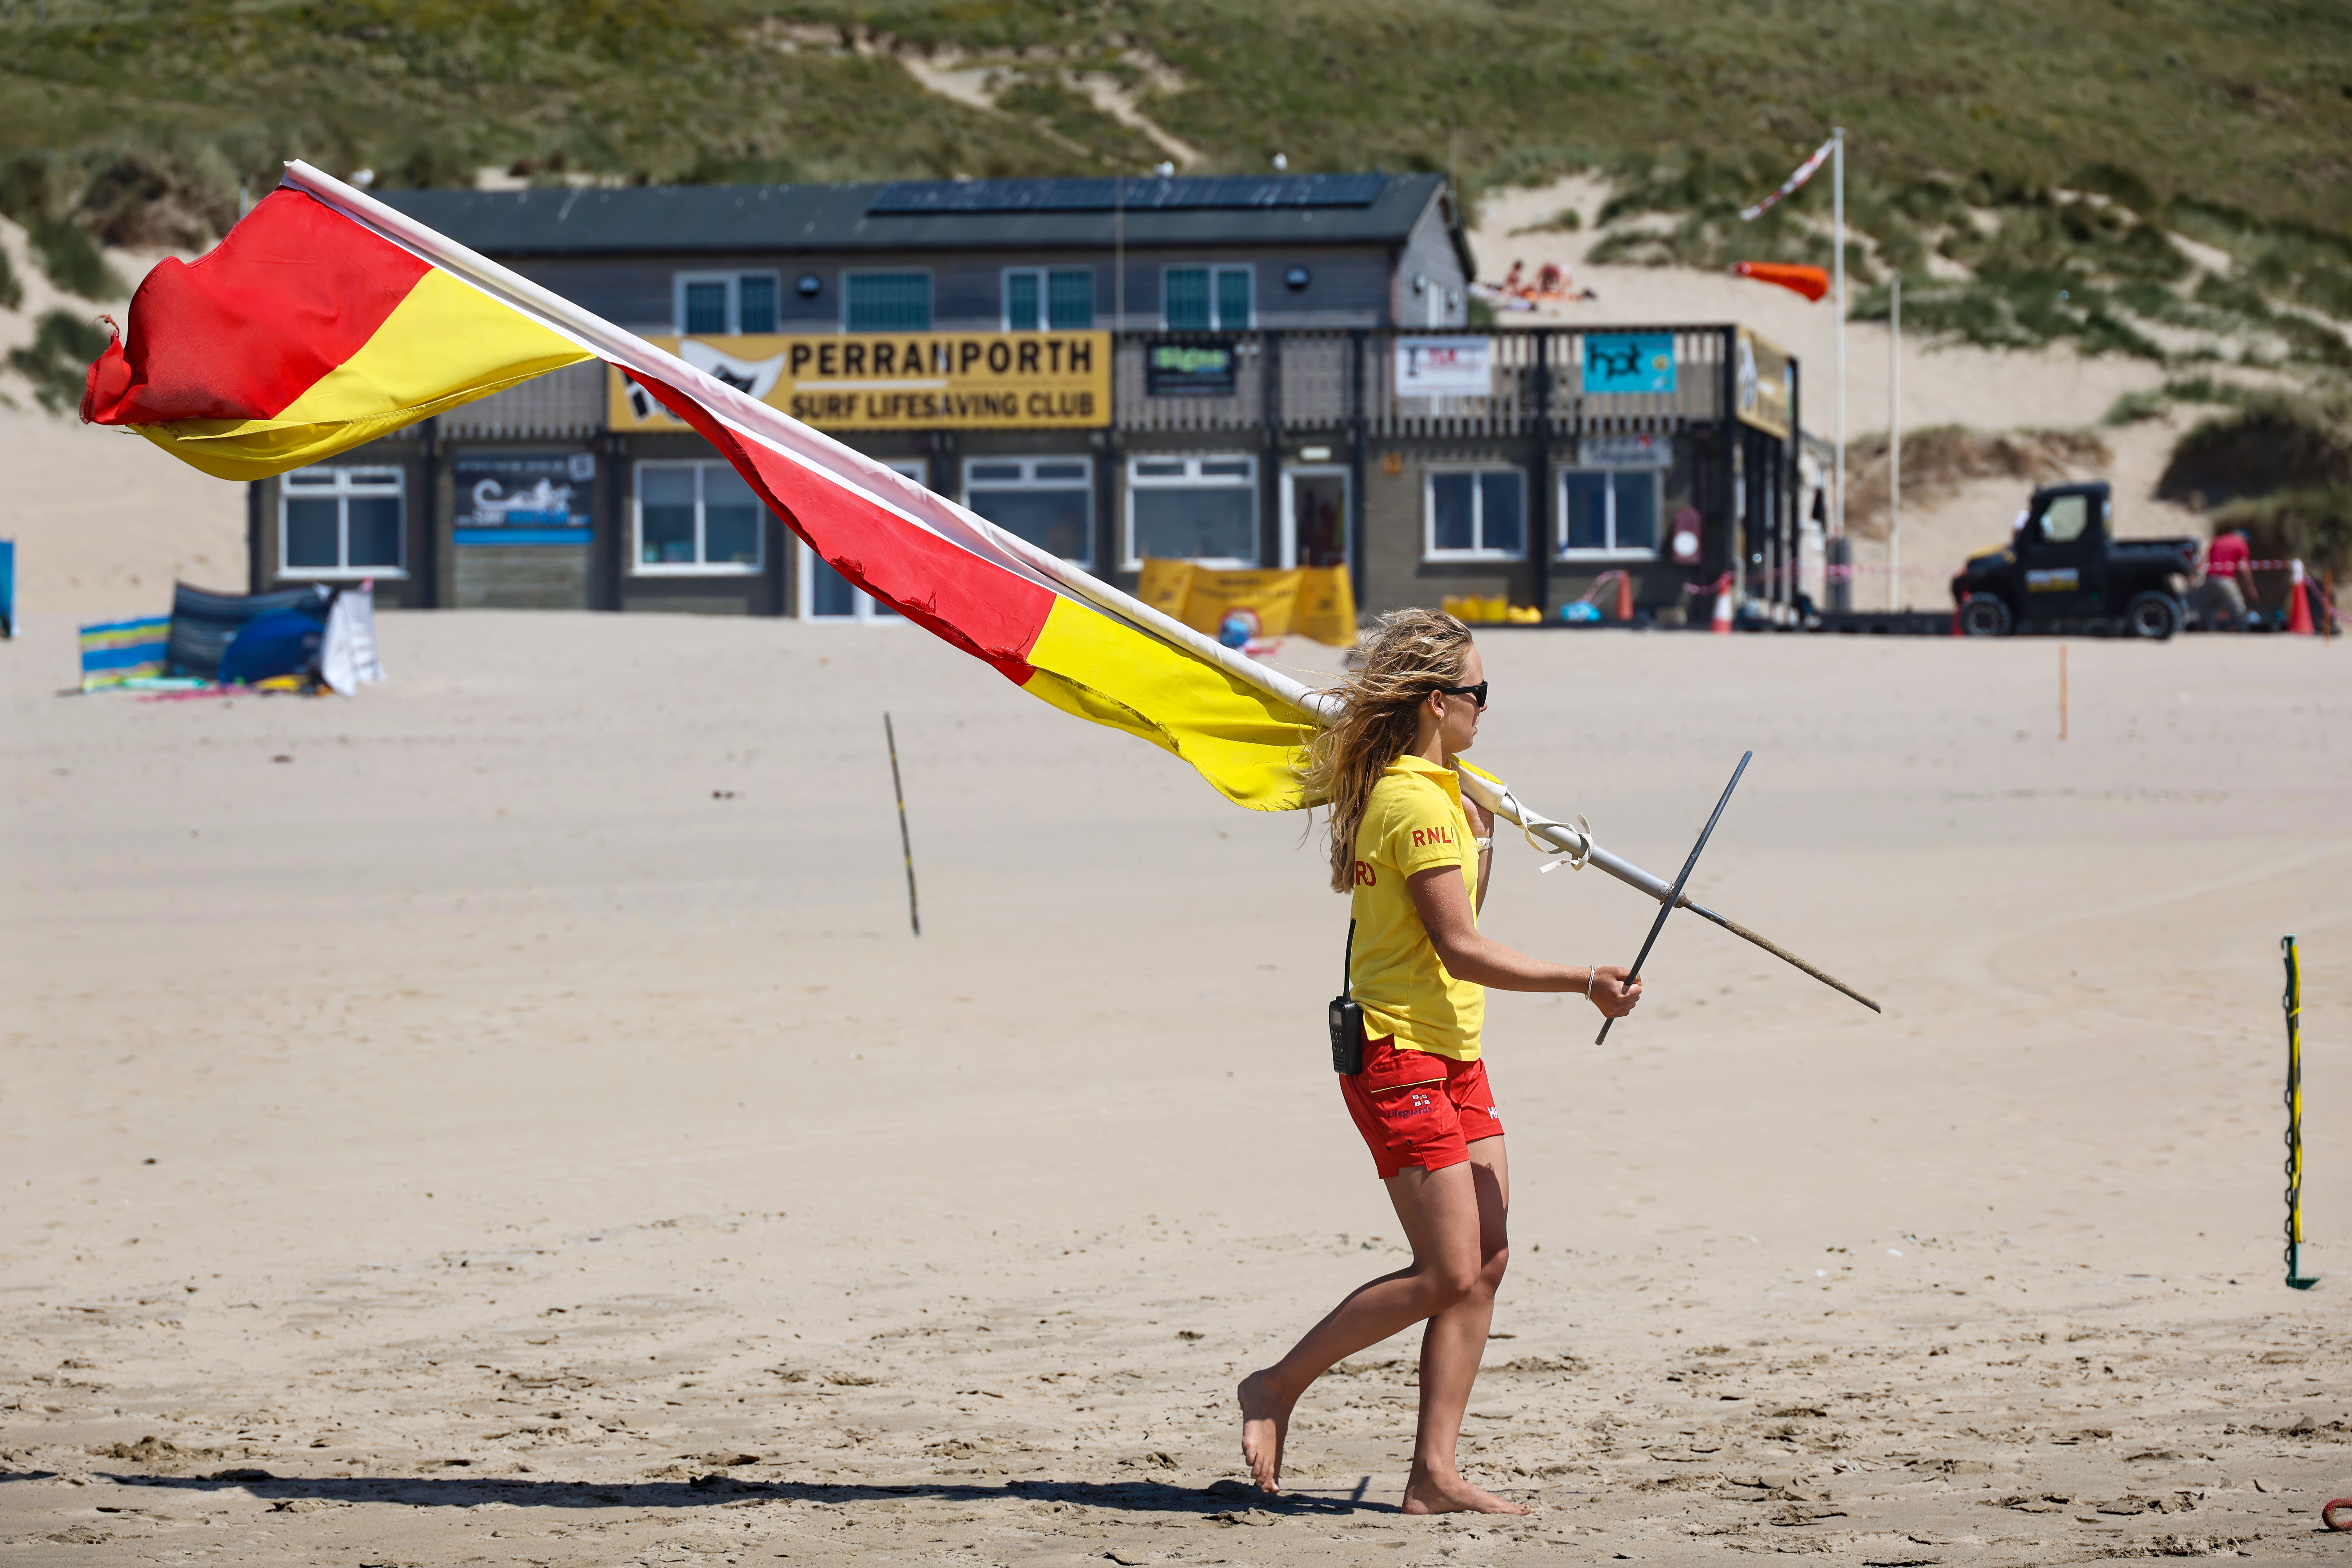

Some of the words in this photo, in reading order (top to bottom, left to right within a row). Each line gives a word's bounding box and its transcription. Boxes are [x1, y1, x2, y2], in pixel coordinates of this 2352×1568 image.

[791, 340, 1091, 375] PERRANPORTH
[792, 394, 858, 419] SURF
[867, 392, 1018, 418] LIFESAVING
[1027, 392, 1094, 417] CLUB
[1388, 1105, 1433, 1118] Lifeguards
